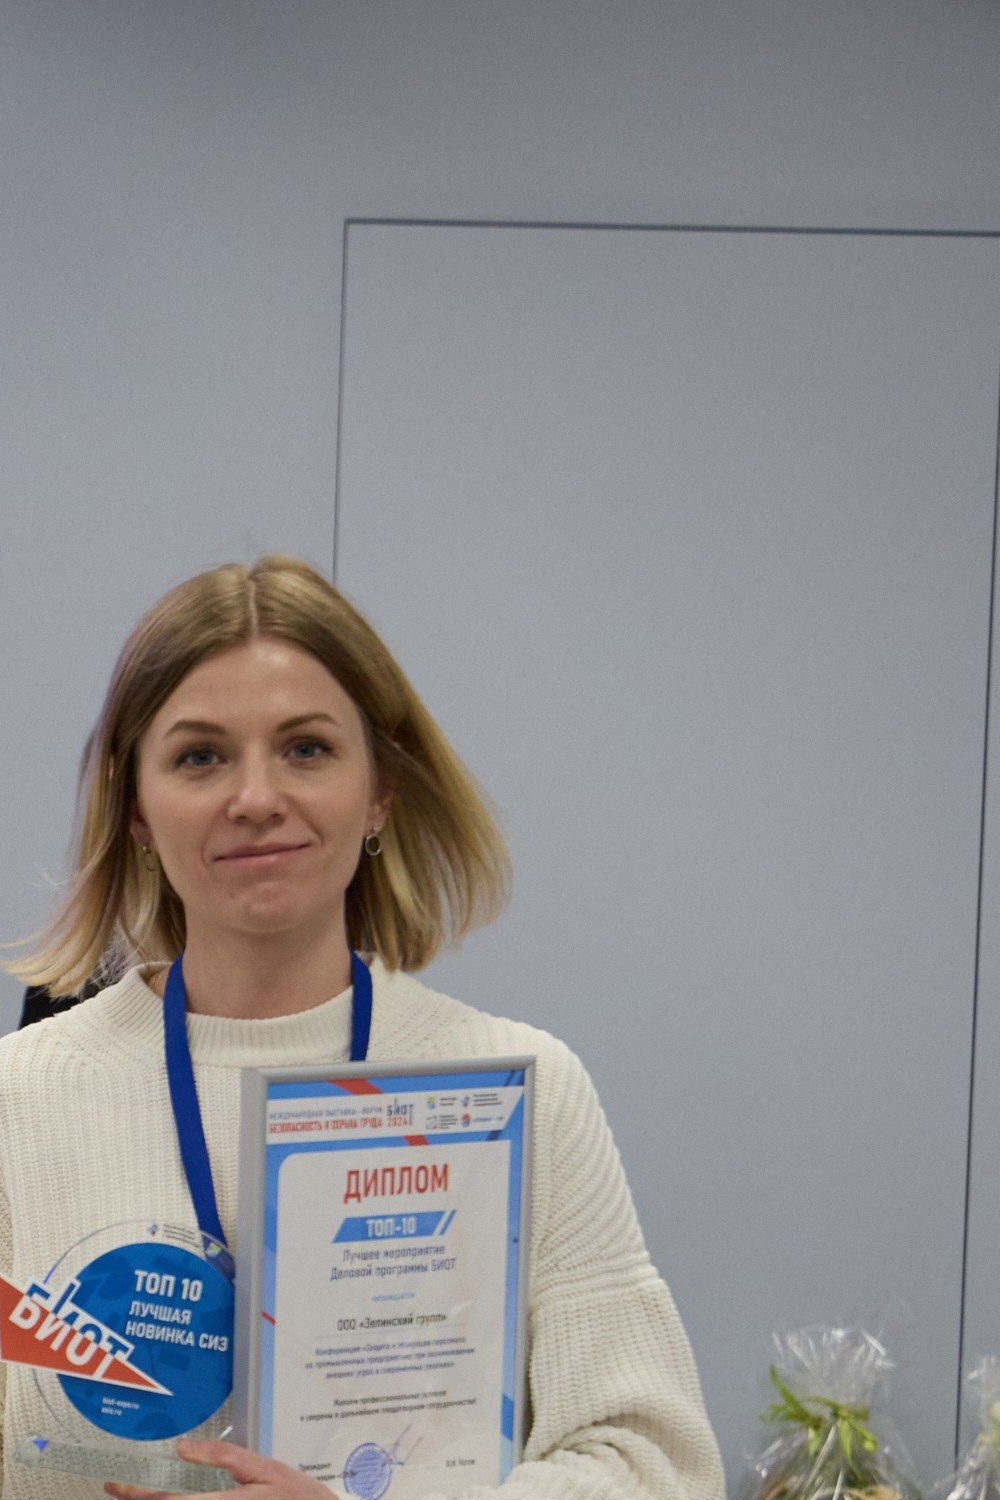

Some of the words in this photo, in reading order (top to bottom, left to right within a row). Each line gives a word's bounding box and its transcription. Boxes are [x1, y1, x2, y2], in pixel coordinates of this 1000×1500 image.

[387, 1098, 414, 1126] БИОТ
[269, 1121, 323, 1134] БЕЗОПАСНОСТЬ
[332, 1118, 358, 1130] ОХРАНА
[360, 1117, 382, 1129] ТРУДА
[343, 1163, 449, 1204] ДИПЛОМ
[366, 1216, 417, 1238] ТОП-10
[343, 1249, 380, 1264] Лучшее
[383, 1244, 445, 1261] мероприятие
[329, 1263, 372, 1281] Деловой
[375, 1261, 428, 1278] программы
[431, 1257, 457, 1271] БИОТ
[134, 1269, 175, 1298] ТОП
[181, 1278, 204, 1302] 10
[129, 1300, 193, 1325] ЛУЧШАЯ
[337, 1318, 356, 1332] ООО
[358, 1312, 413, 1330] «Зелинский
[415, 1312, 447, 1327] групп»
[8, 1281, 131, 1379] БИОТ
[125, 1320, 195, 1347] НОВИНКА
[198, 1332, 230, 1352] СИЗ
